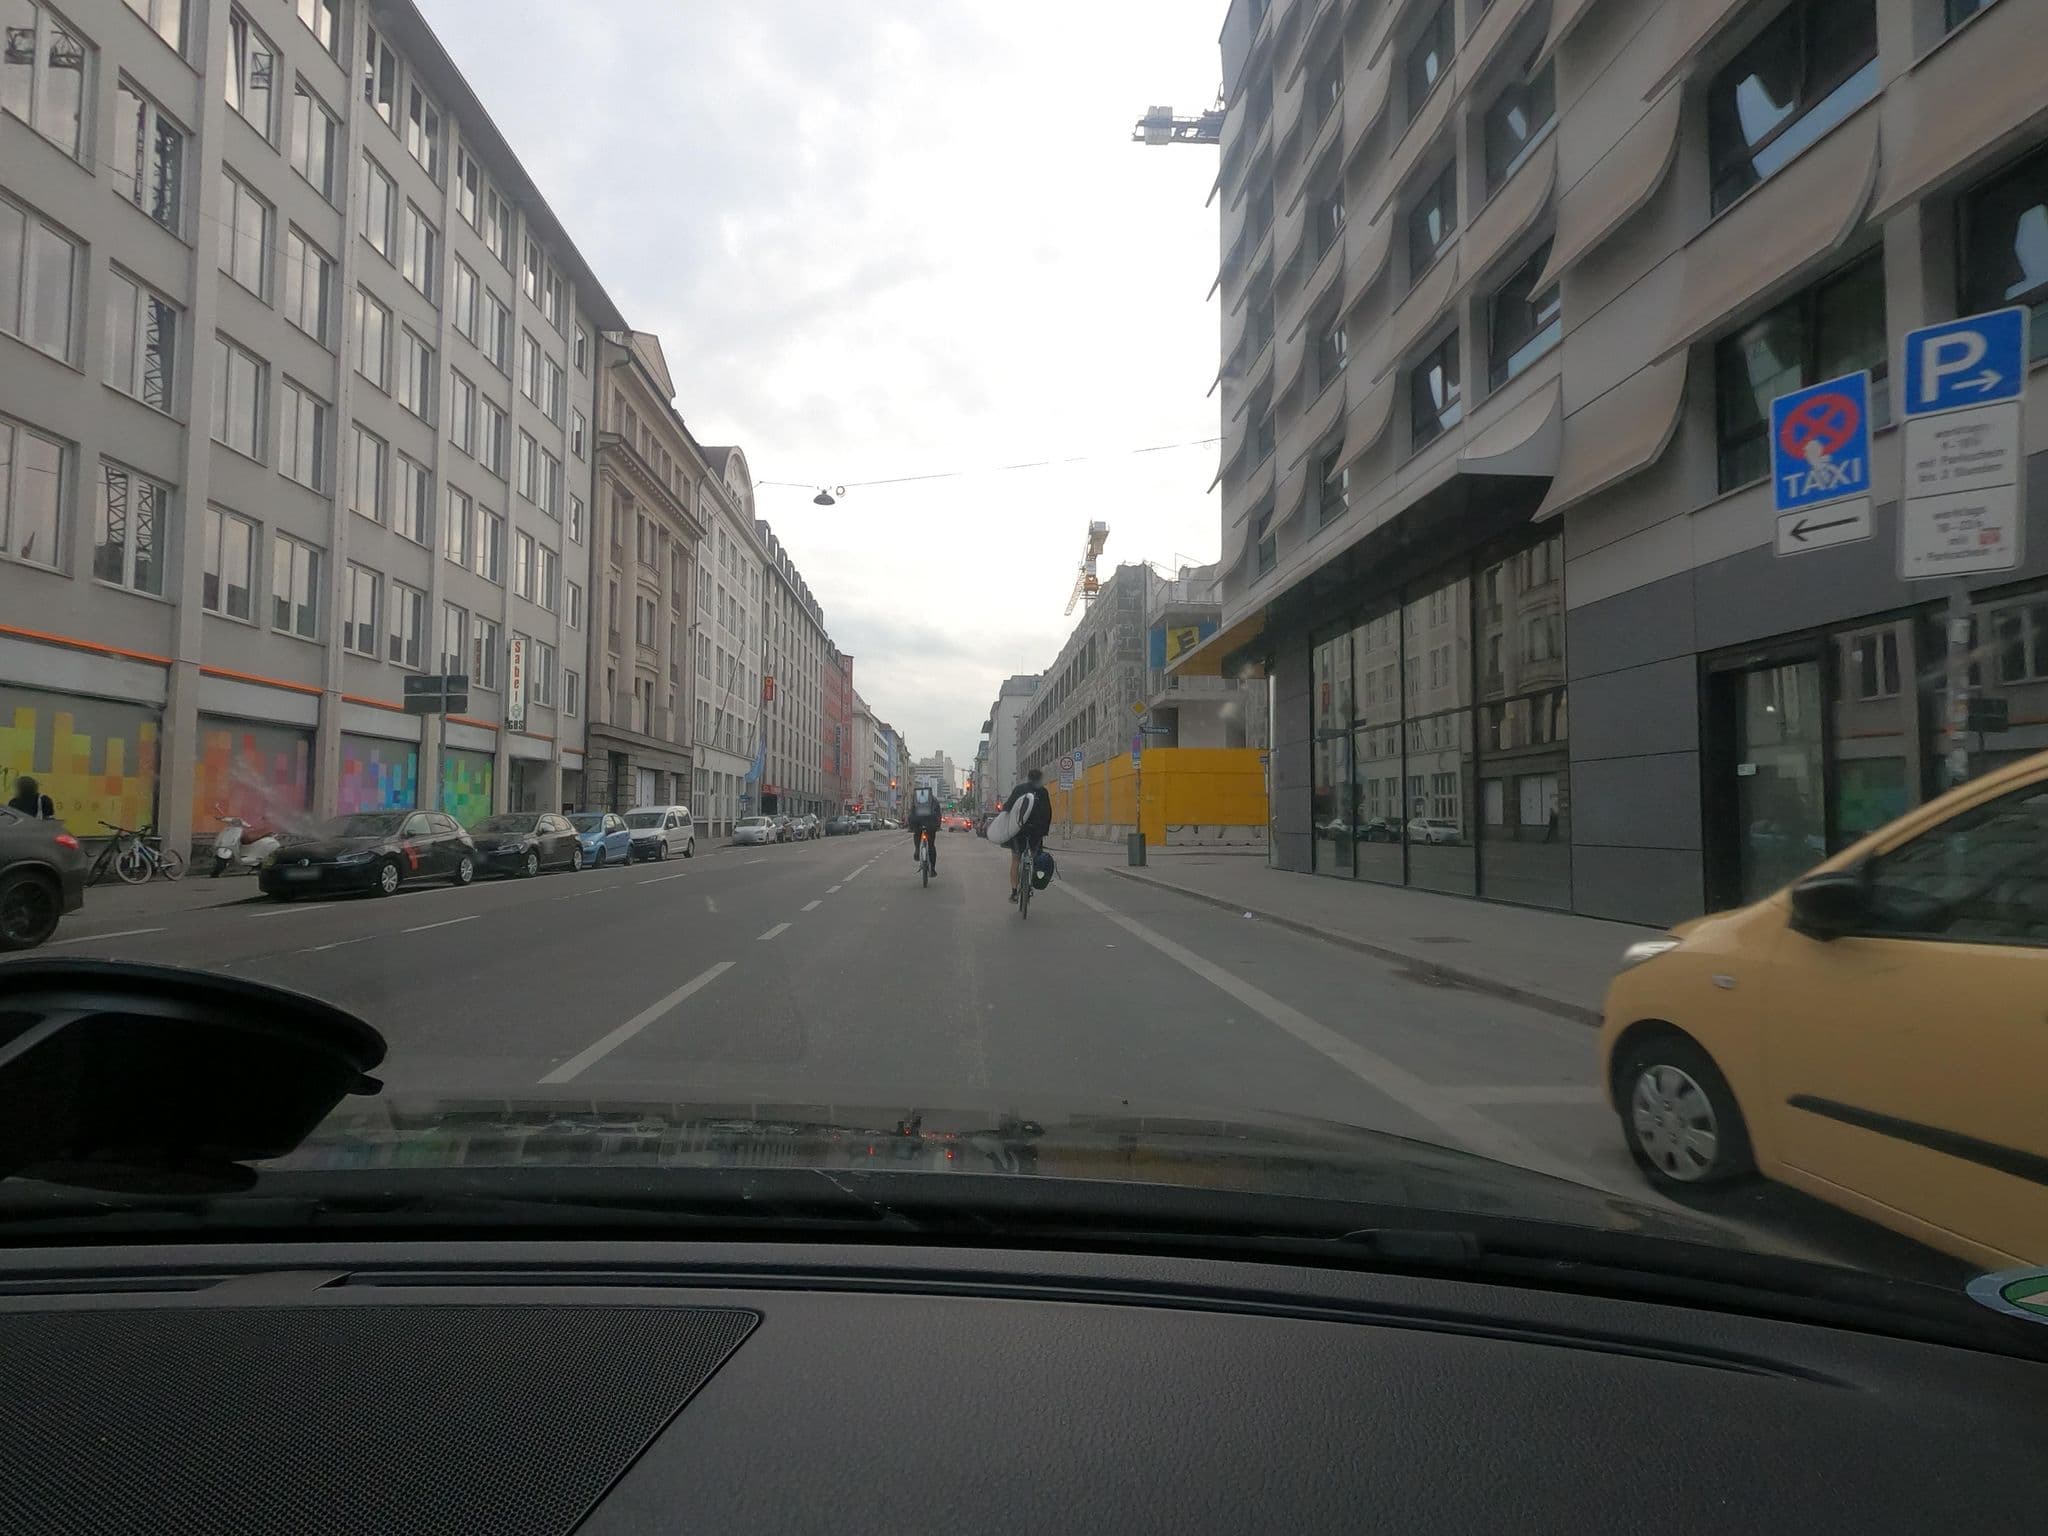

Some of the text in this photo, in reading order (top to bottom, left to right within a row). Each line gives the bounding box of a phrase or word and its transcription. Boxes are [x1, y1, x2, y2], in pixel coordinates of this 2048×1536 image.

[1919, 330, 1988, 404] P
[1782, 456, 1862, 499] TAXI
[513, 640, 522, 703] Sabel
